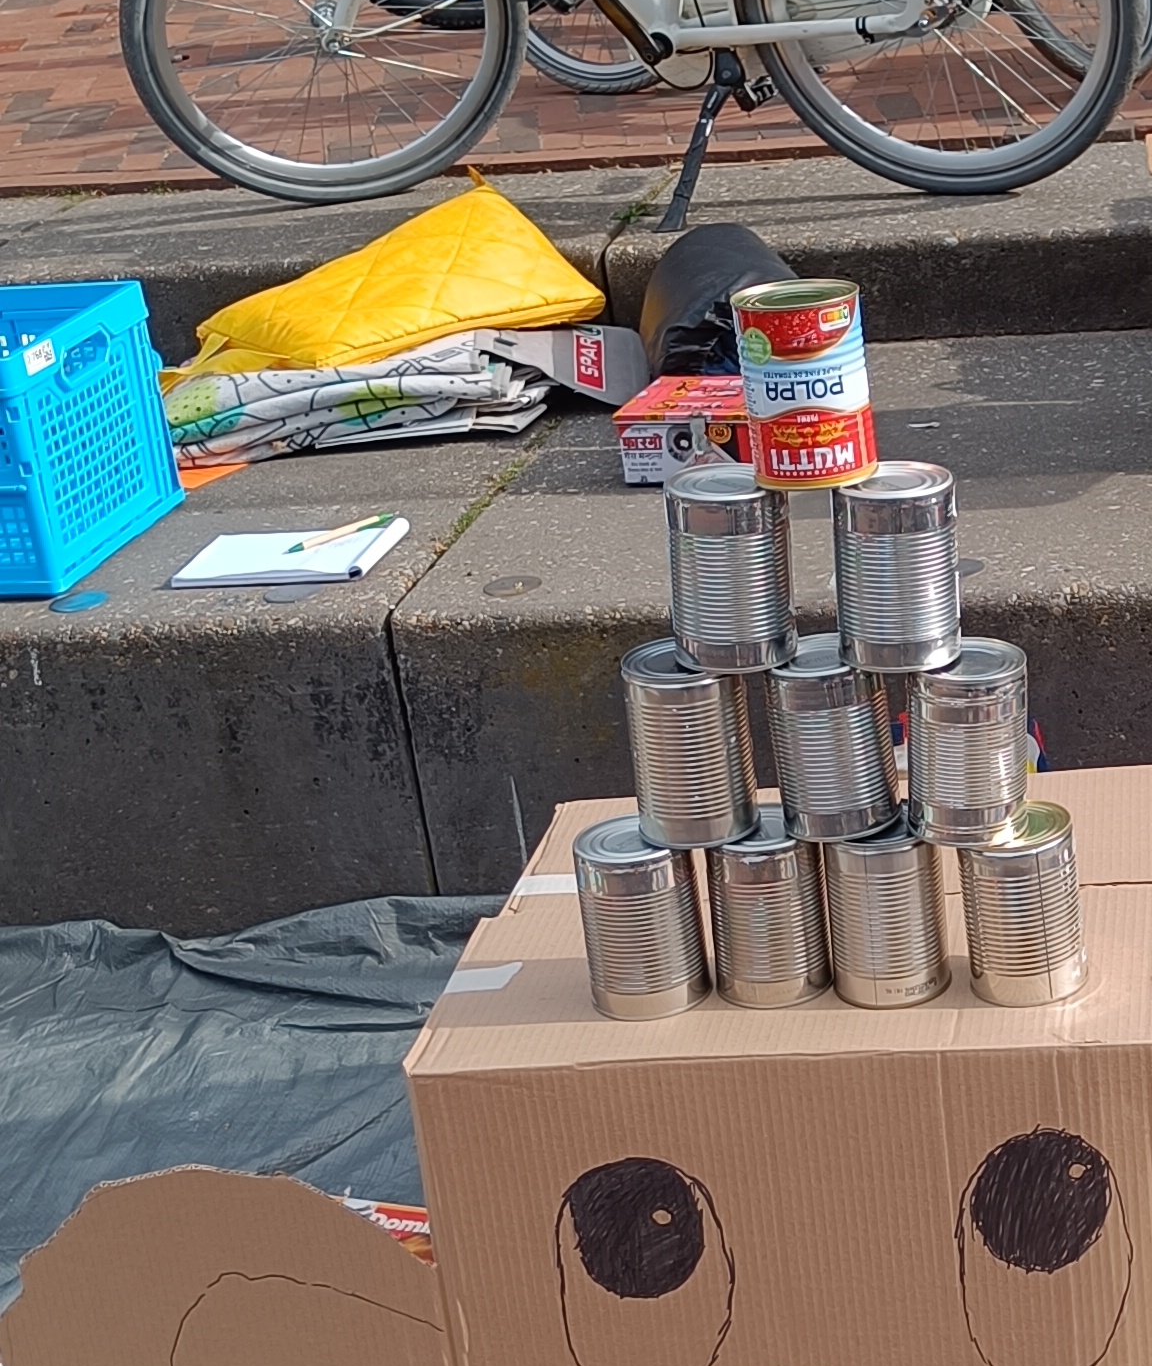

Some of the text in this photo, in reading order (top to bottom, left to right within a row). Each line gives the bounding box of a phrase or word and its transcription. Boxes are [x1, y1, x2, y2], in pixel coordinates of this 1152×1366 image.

[580, 336, 599, 378] SPAR
[763, 371, 792, 379] TOMATES
[793, 370, 803, 378] DE
[765, 376, 844, 401] POLPA
[770, 441, 854, 471] MUTTI
